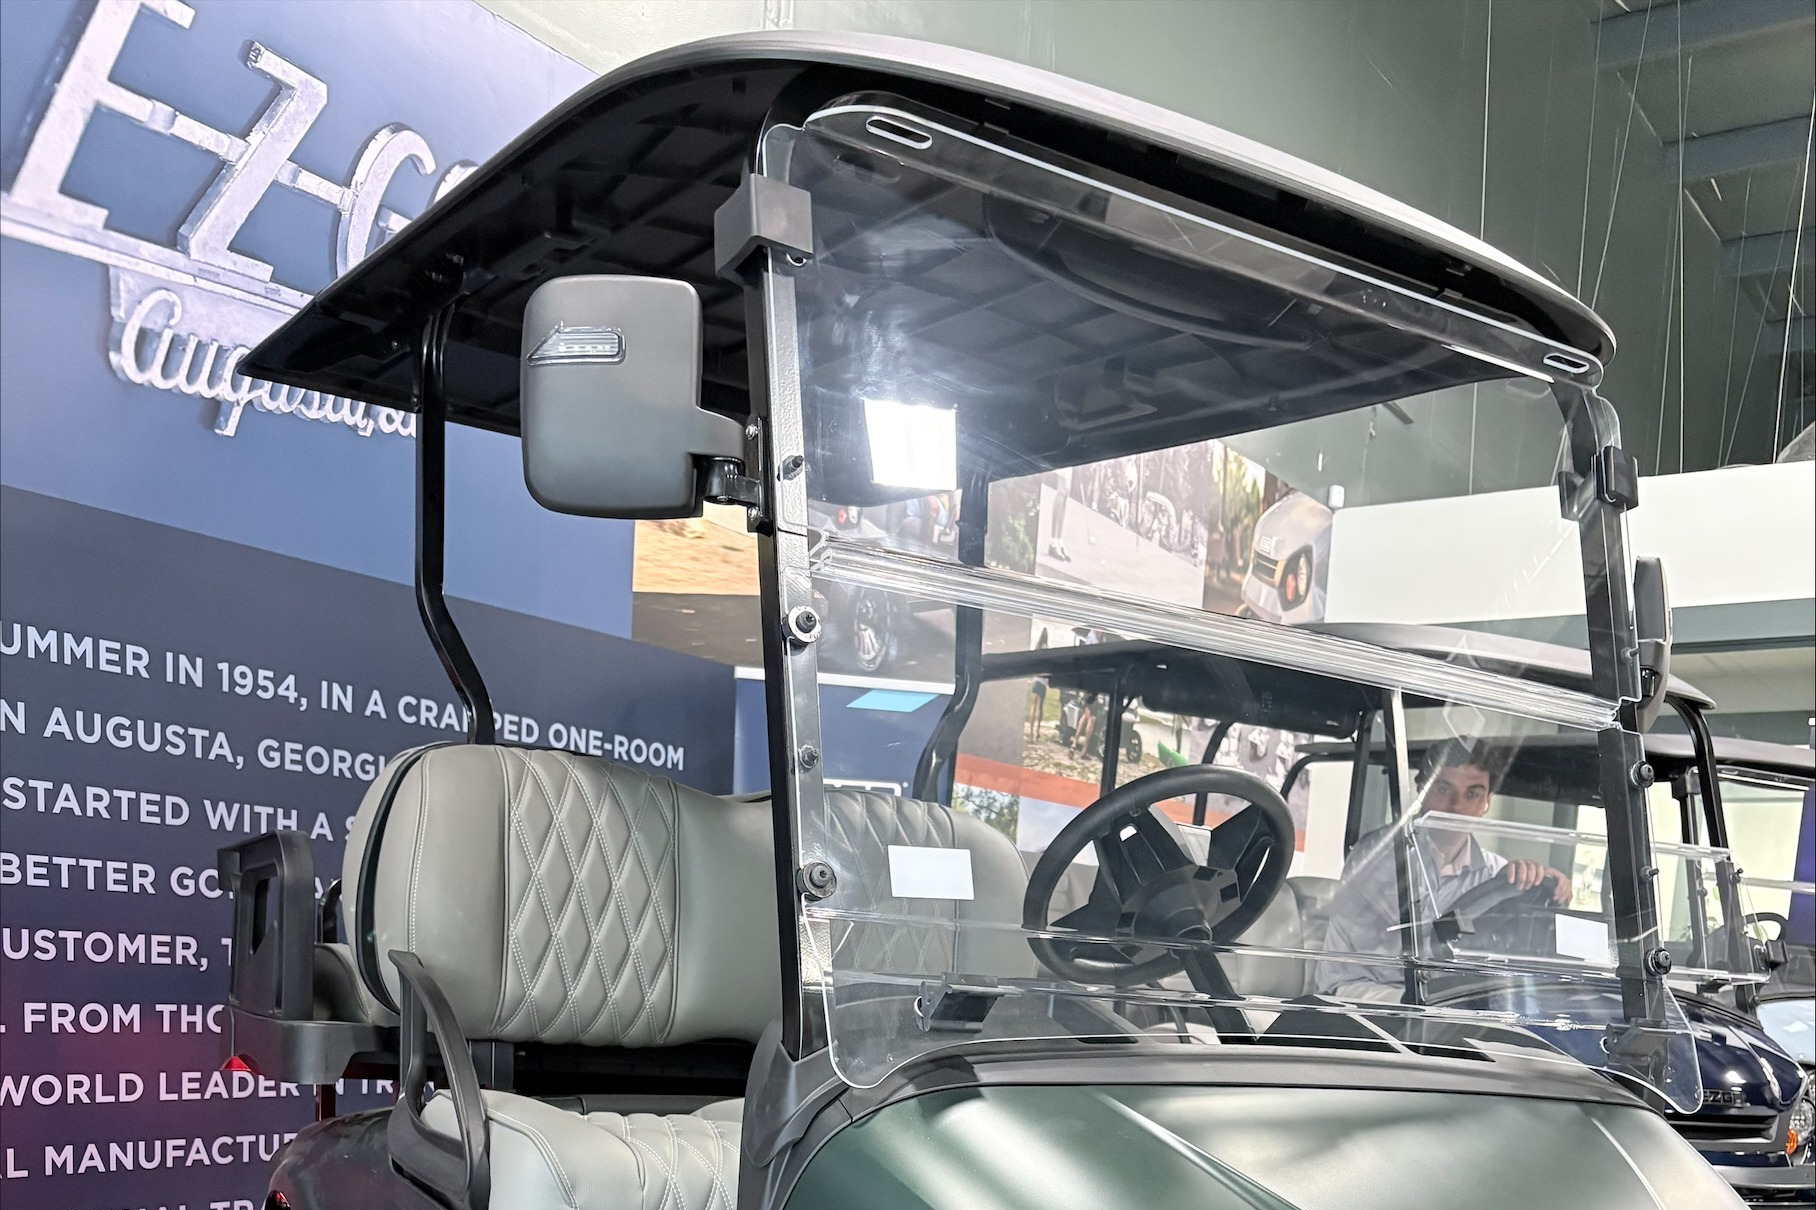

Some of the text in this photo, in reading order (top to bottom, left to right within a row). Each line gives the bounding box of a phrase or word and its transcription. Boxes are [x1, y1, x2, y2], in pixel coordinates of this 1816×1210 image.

[165, 651, 203, 688] IN
[217, 662, 308, 711] 1954,
[320, 680, 353, 713] IN
[364, 689, 387, 719] A
[398, 695, 540, 744] CRAED
[548, 722, 684, 771] ONE-ROOM
[43, 706, 244, 770] AUGUSTA,
[257, 738, 386, 782] GEORGI
[2, 776, 190, 826] STARTED
[203, 799, 298, 834] WITH
[310, 811, 334, 842] A
[0, 853, 156, 894] BETTER
[24, 1002, 141, 1034] FROM
[0, 1073, 144, 1106] WORLD
[159, 1070, 300, 1101] LEADER
[45, 1132, 299, 1176] MANUFACTU
